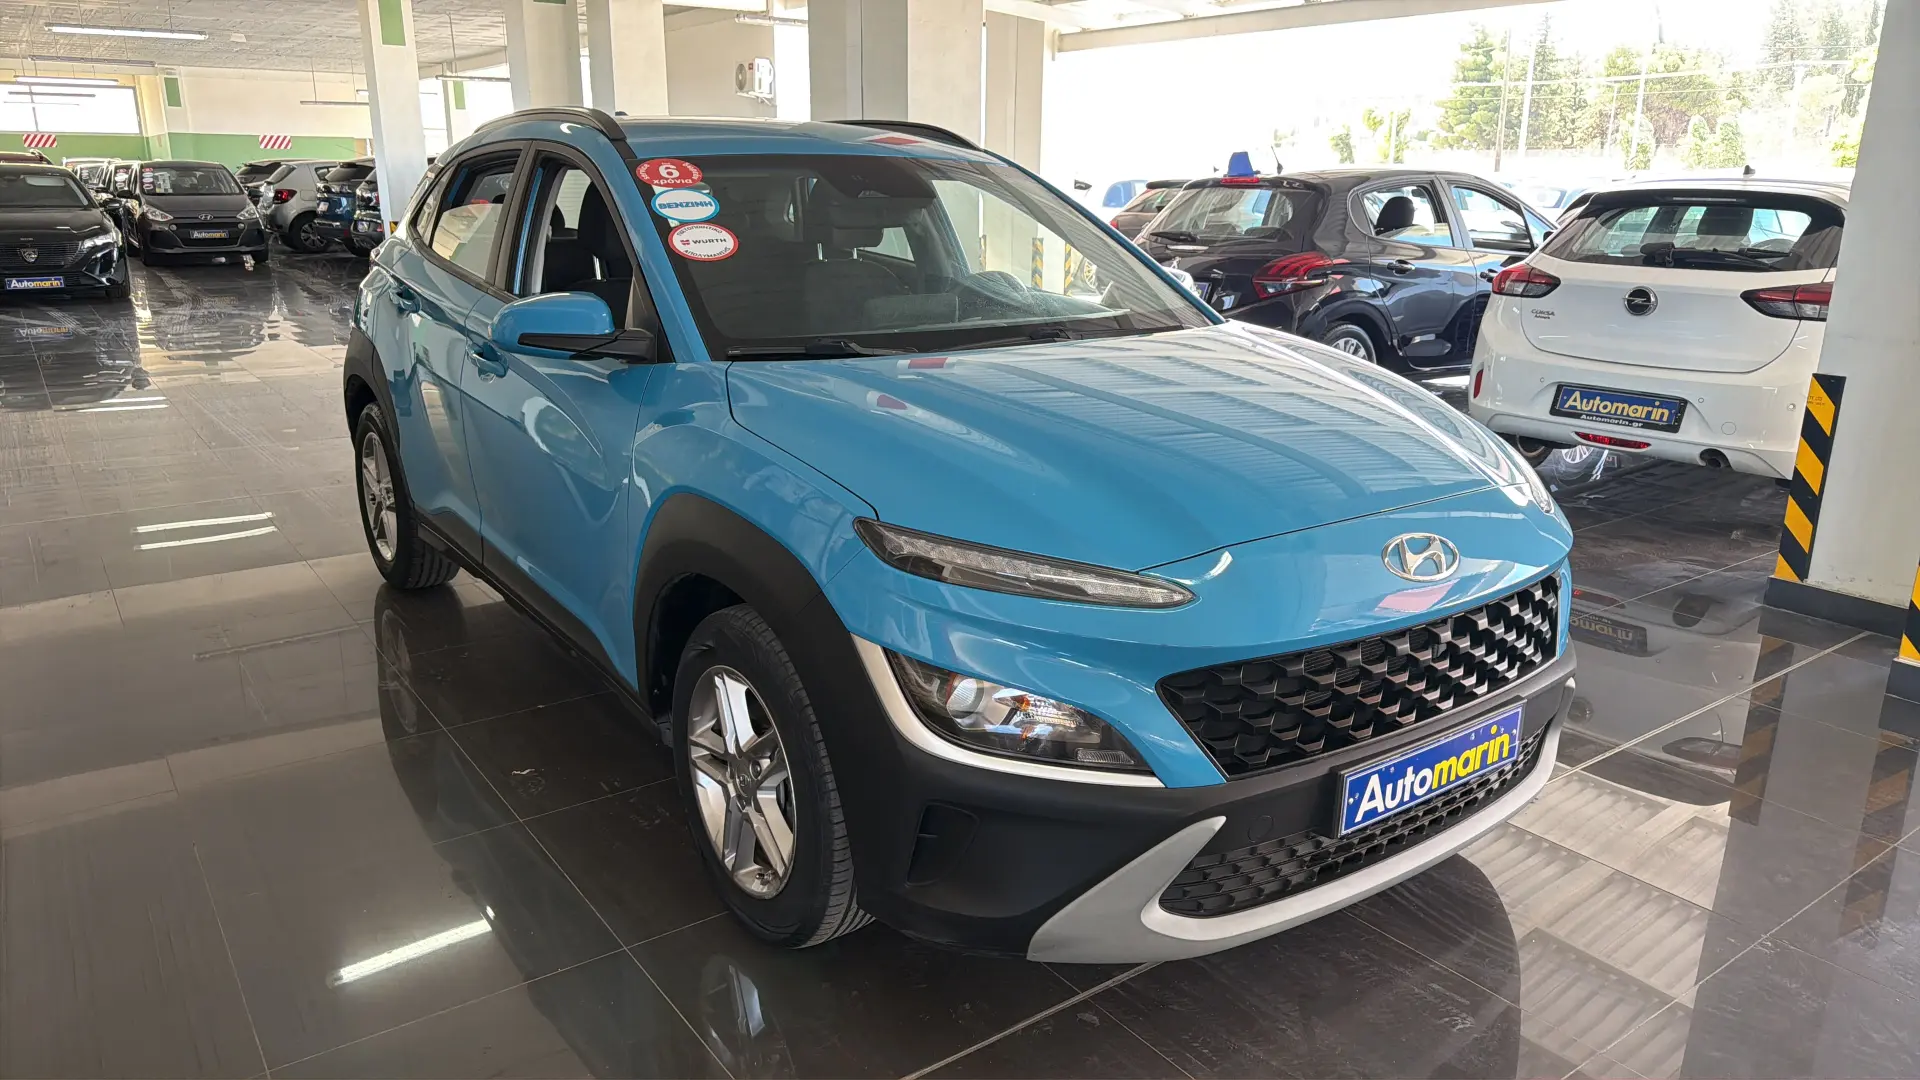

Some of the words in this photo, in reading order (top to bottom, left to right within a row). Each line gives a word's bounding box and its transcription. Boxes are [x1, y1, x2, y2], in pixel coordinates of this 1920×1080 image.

[659, 164, 680, 178] 6
[193, 230, 227, 239] Automarin
[10, 277, 61, 288] Automarin
[1564, 390, 1670, 422] Automarin
[1580, 414, 1643, 428] Automarin.gr
[1355, 724, 1510, 823] Automarin
